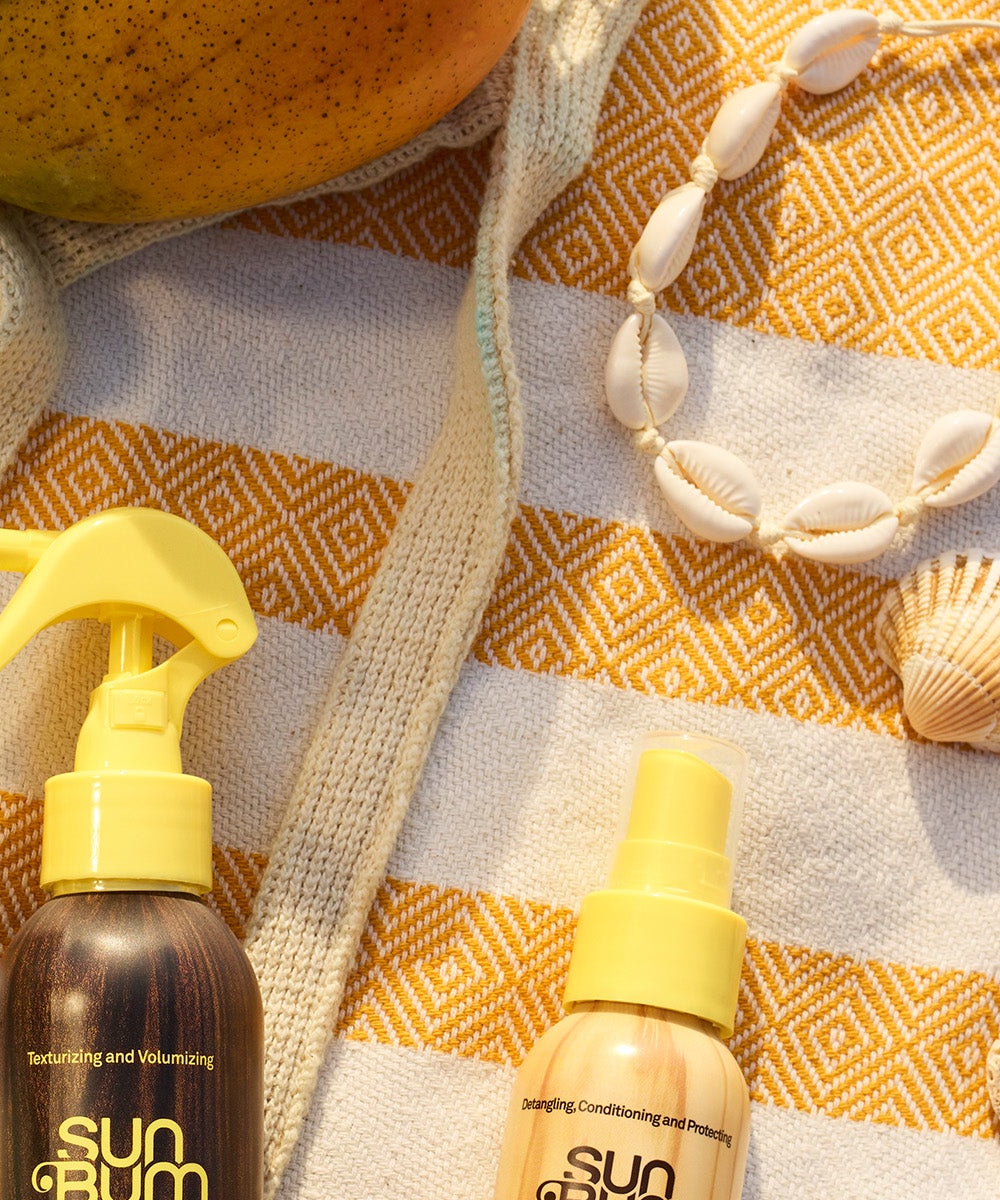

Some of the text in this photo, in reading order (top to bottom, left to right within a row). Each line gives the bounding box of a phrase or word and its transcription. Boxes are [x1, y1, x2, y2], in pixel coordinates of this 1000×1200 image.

[27, 1050, 214, 1070] Texturizing and Volumizing
[522, 1098, 732, 1148] Detangling, Conditioning and Protecting
